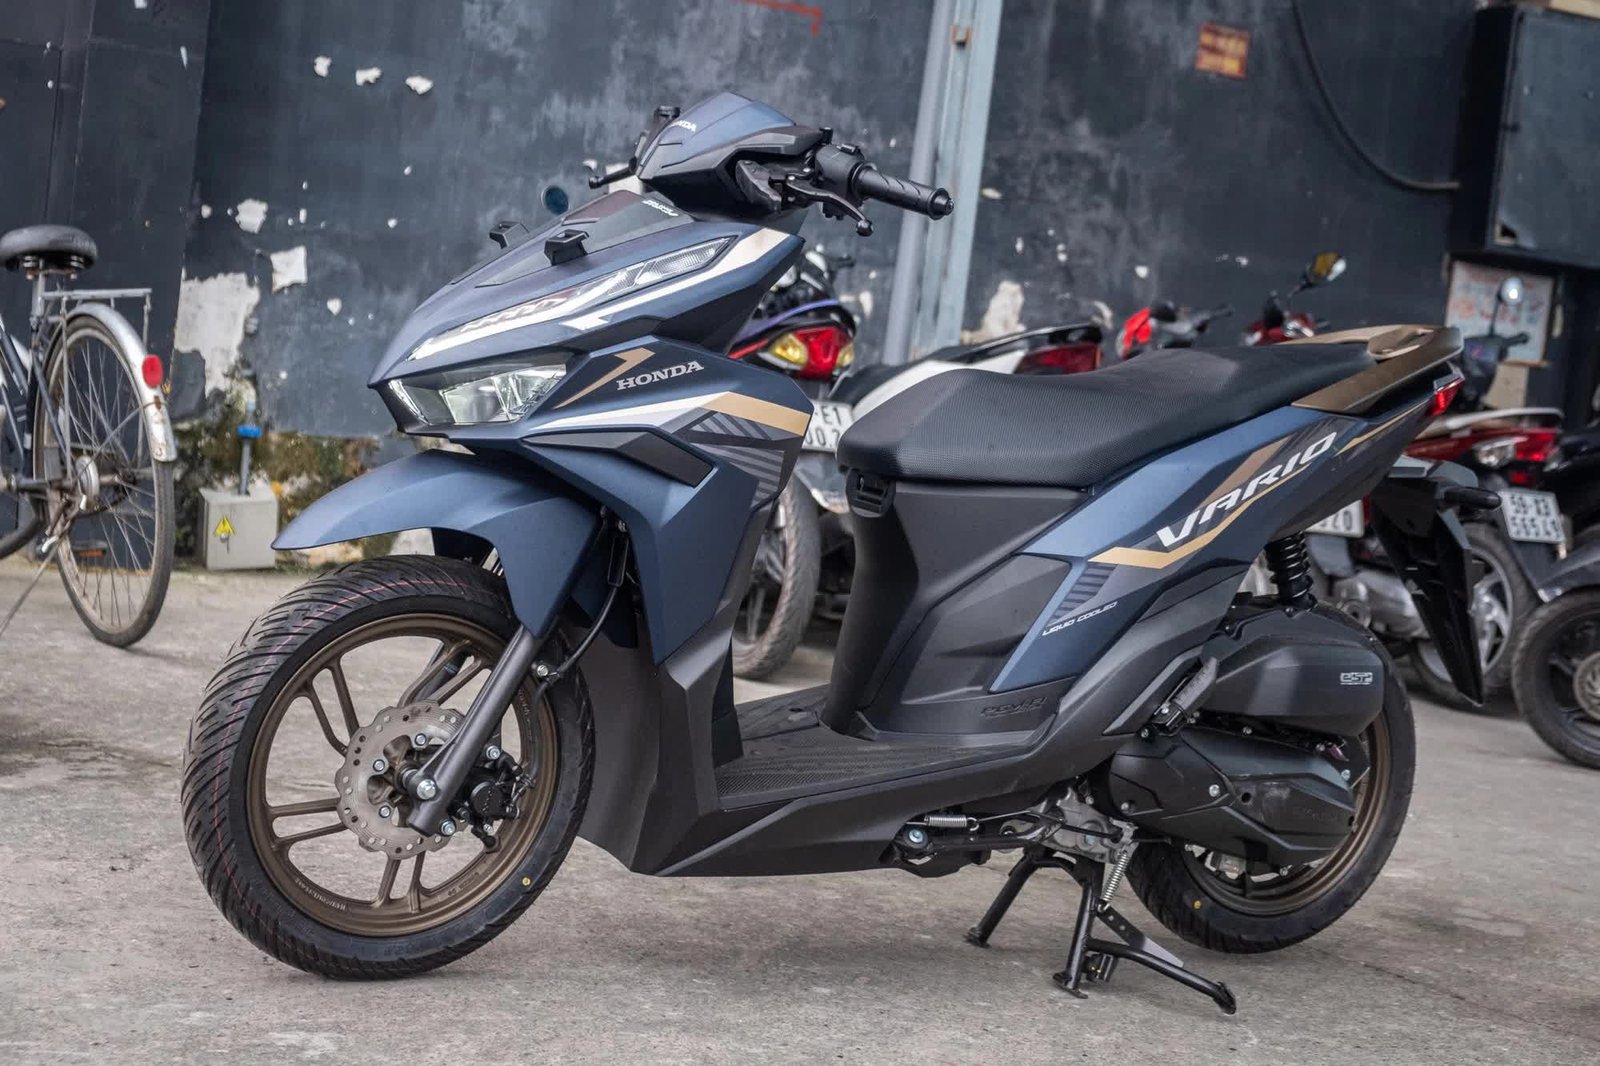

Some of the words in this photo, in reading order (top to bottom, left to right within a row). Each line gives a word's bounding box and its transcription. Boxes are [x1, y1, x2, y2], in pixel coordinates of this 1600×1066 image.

[616, 360, 705, 391] HONDA
[1156, 431, 1338, 548] VARIO
[1042, 619, 1076, 636] LIQUID
[1077, 601, 1118, 623] COOLED
